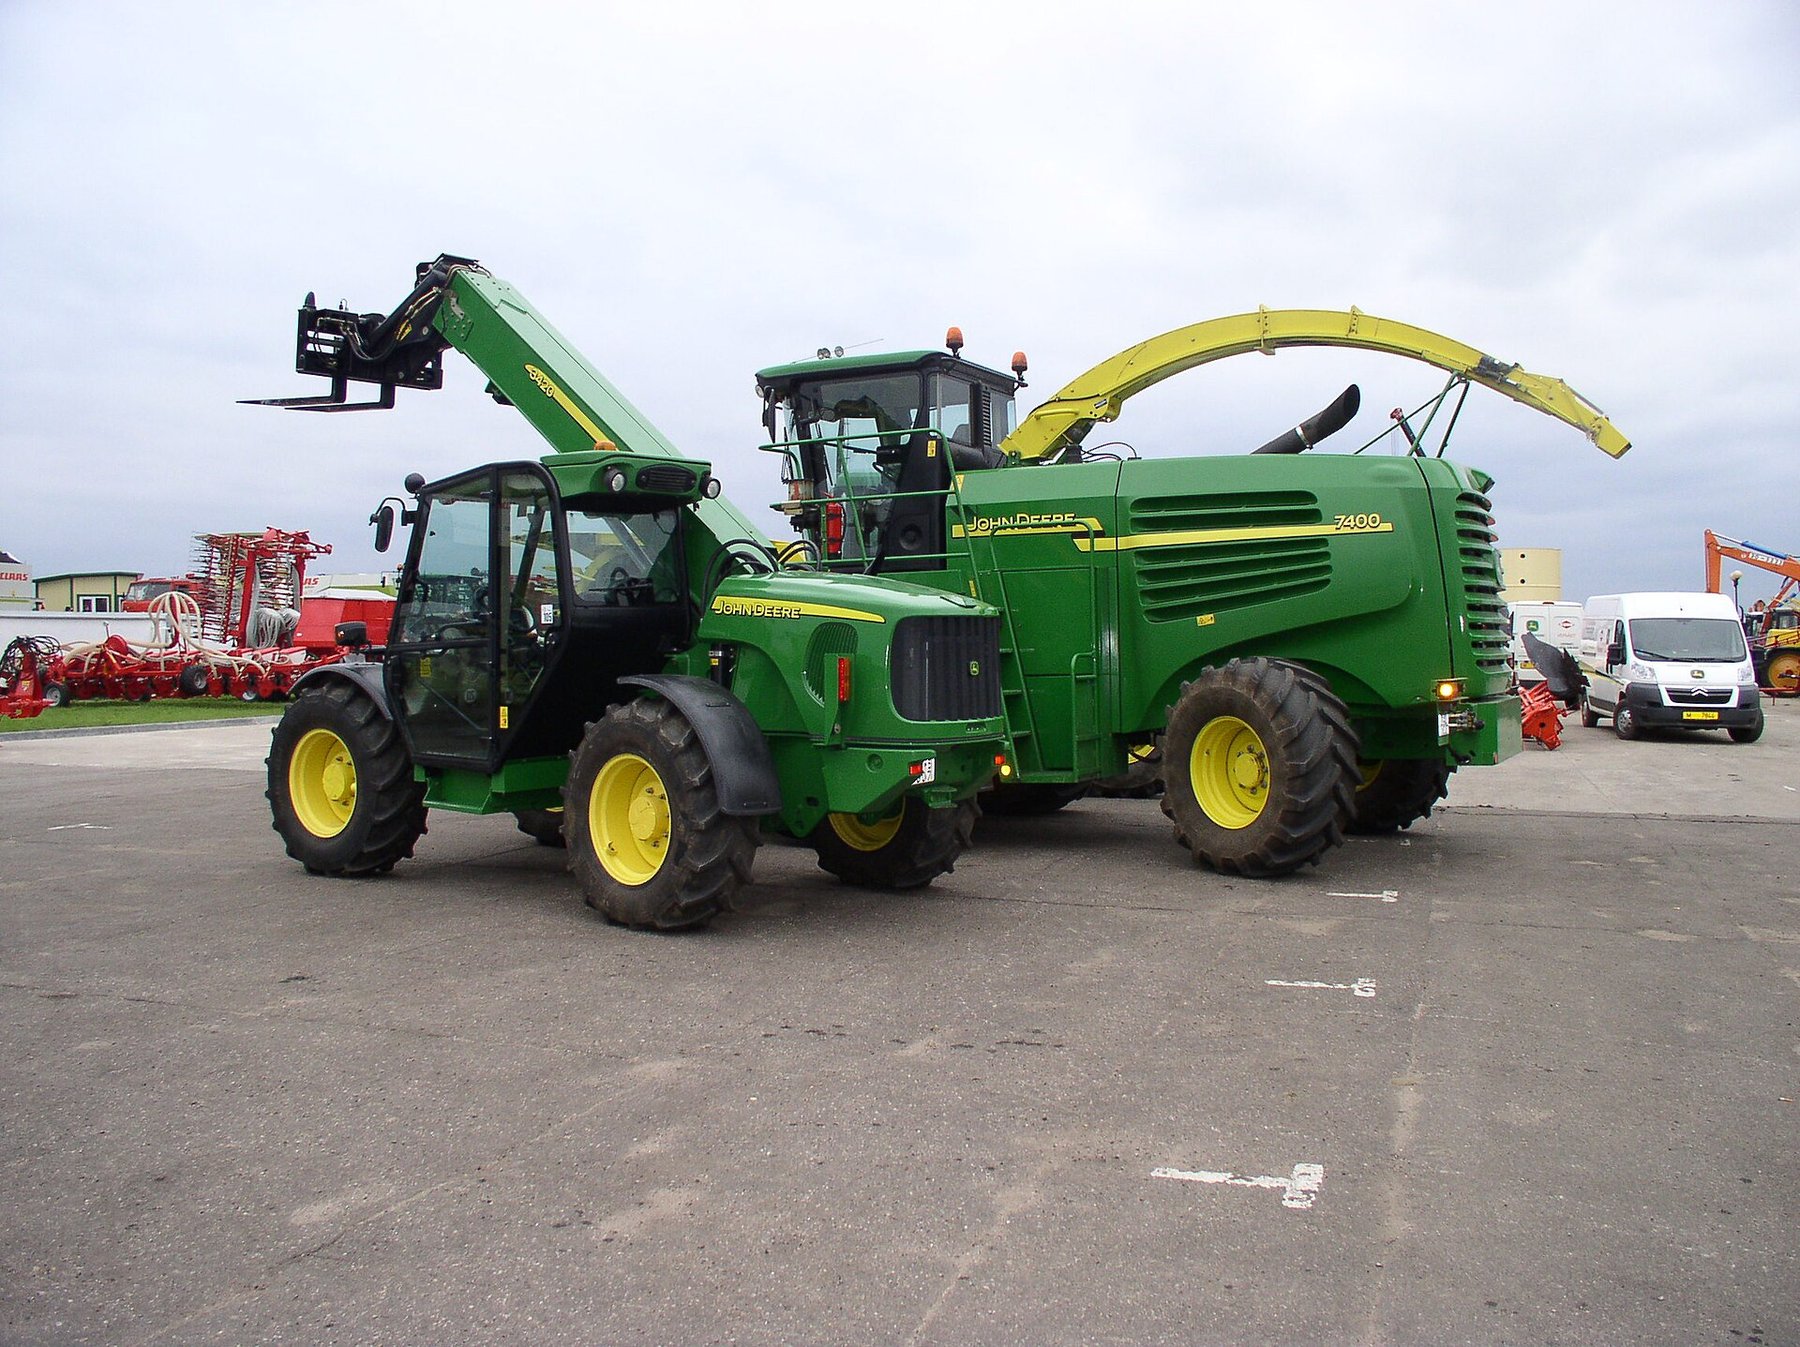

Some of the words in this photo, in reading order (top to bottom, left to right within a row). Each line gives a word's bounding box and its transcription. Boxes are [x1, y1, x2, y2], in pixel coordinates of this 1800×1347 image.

[529, 369, 555, 398] 3420
[967, 516, 1013, 531] JOHN
[1333, 513, 1381, 530] 7400
[714, 600, 753, 616] JOHN
[753, 603, 801, 619] DEERE
